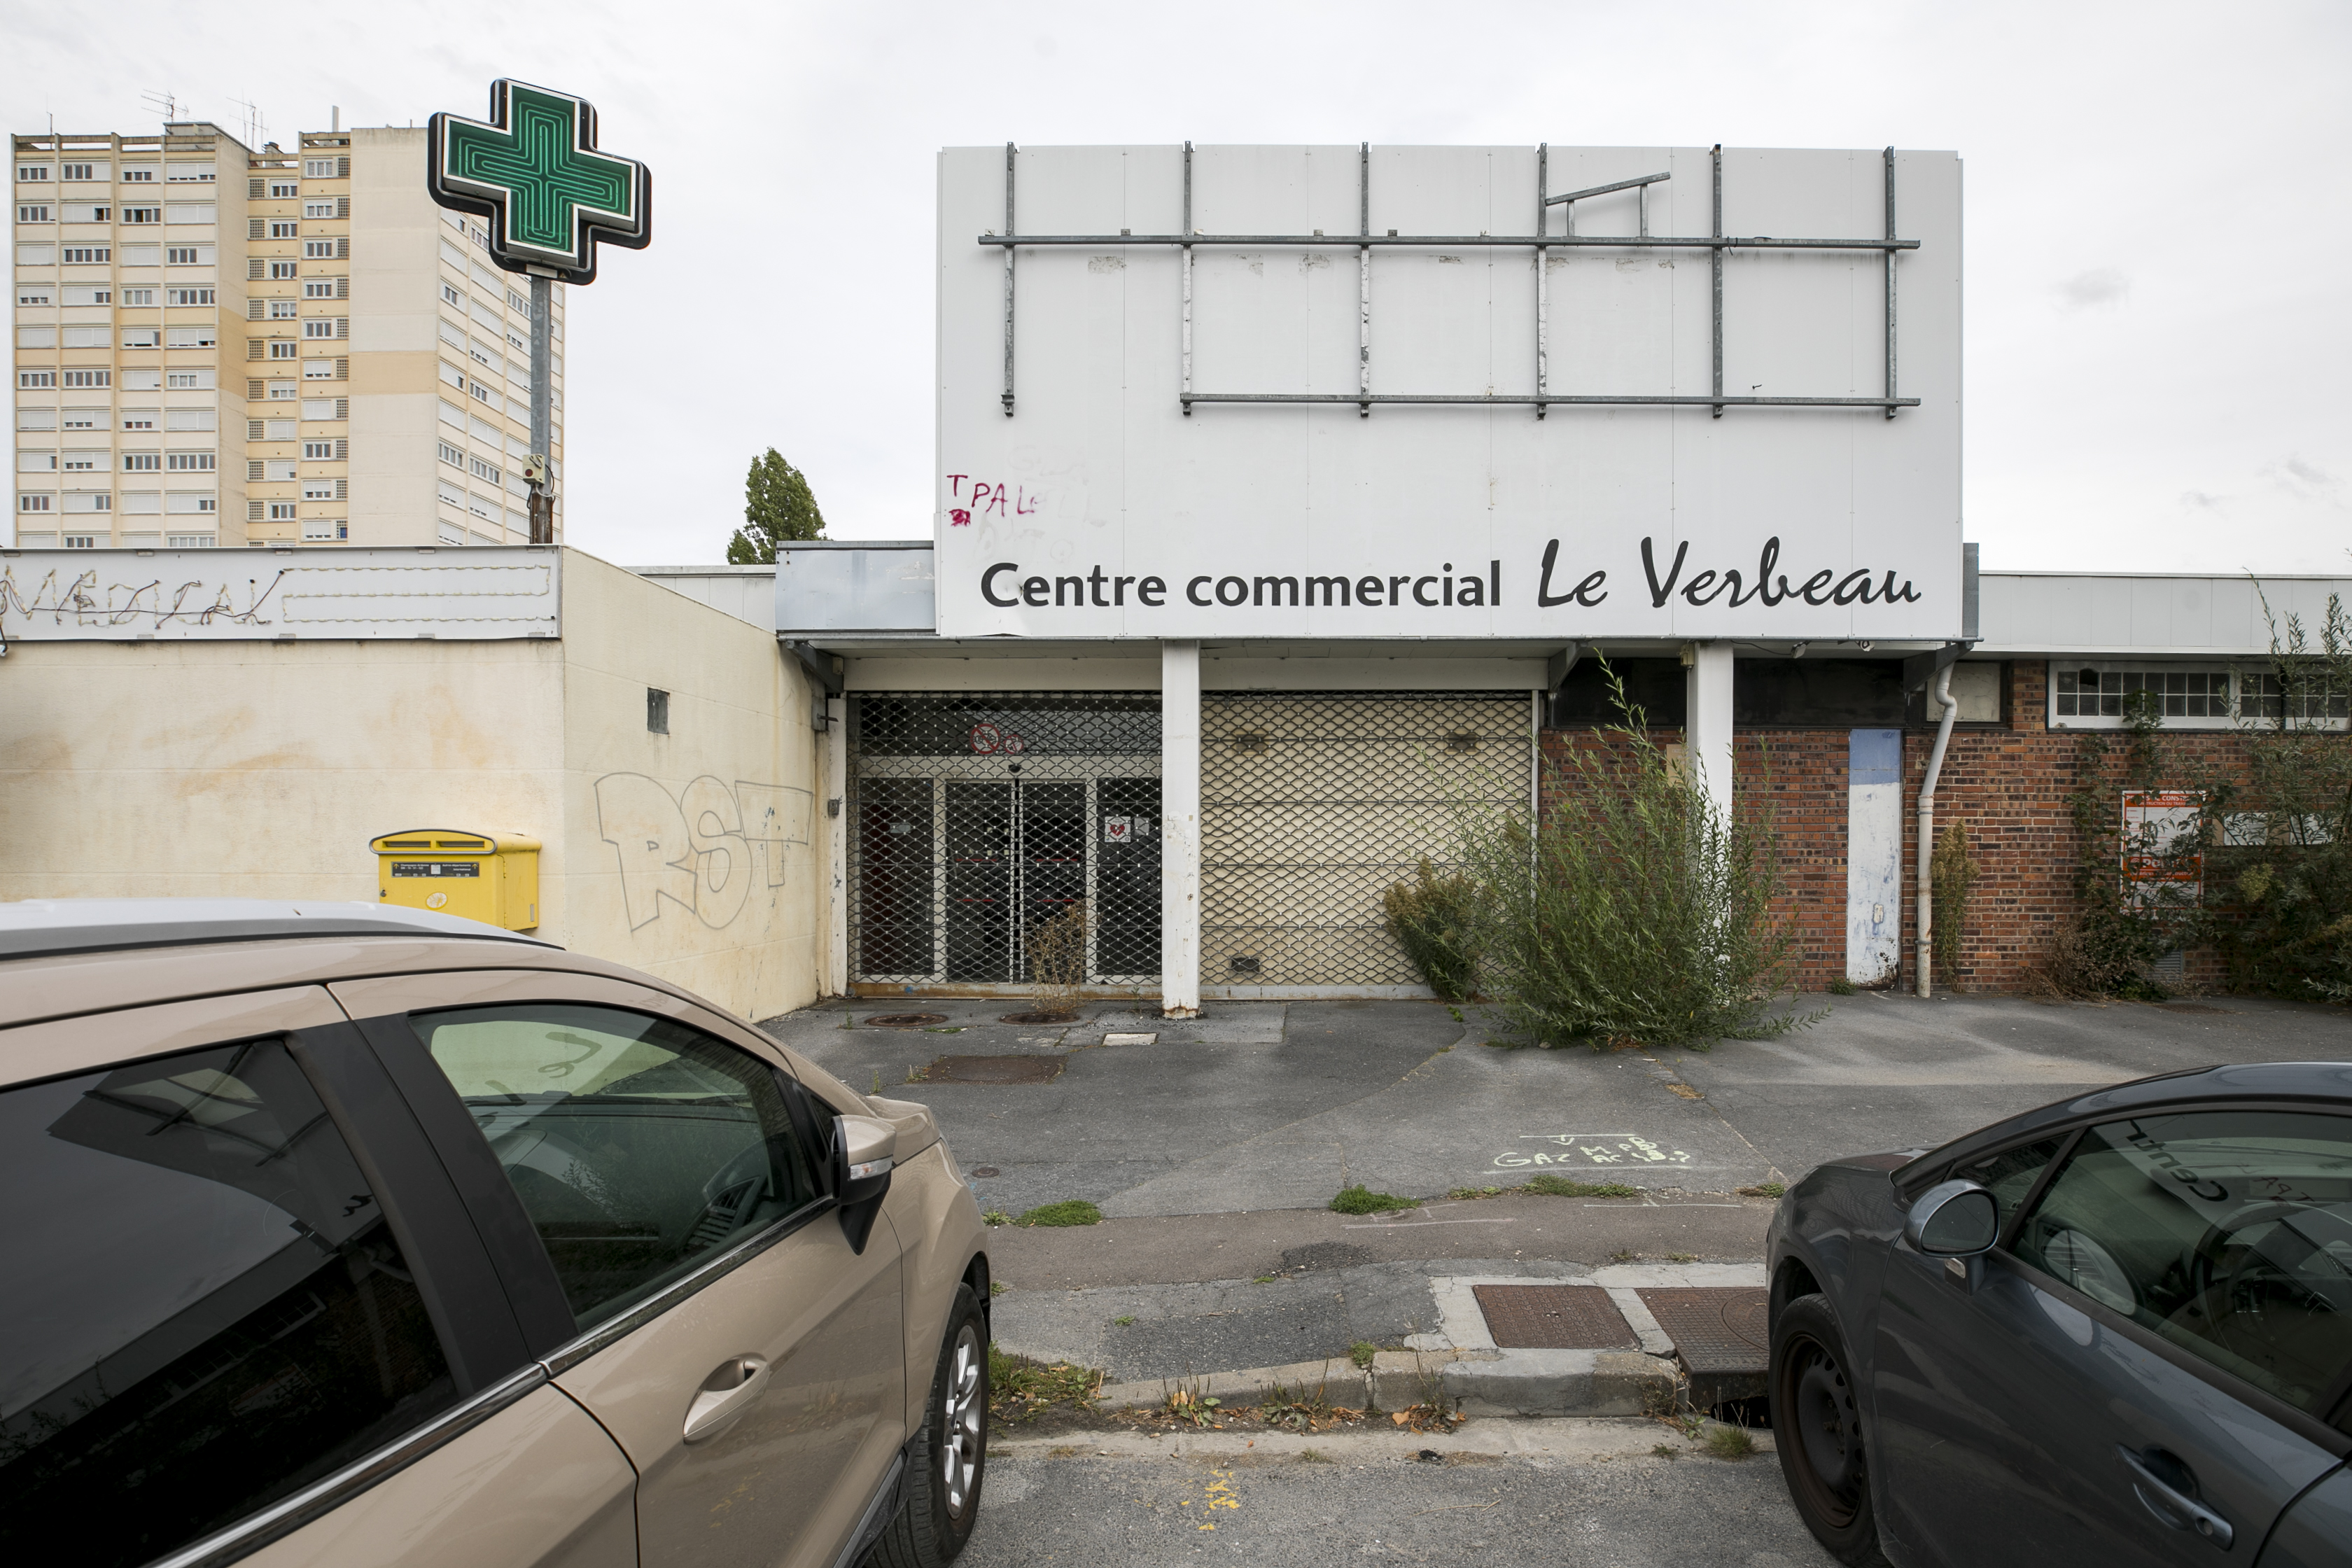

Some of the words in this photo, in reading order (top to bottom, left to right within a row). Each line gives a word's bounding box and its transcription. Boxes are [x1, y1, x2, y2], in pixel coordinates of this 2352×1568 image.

[981, 562, 1168, 608] Centre
[1186, 561, 1501, 608] commercial
[1539, 539, 1609, 608] Le
[1641, 537, 1922, 609] Verbeau
[1493, 1152, 1572, 1168] GAZ
